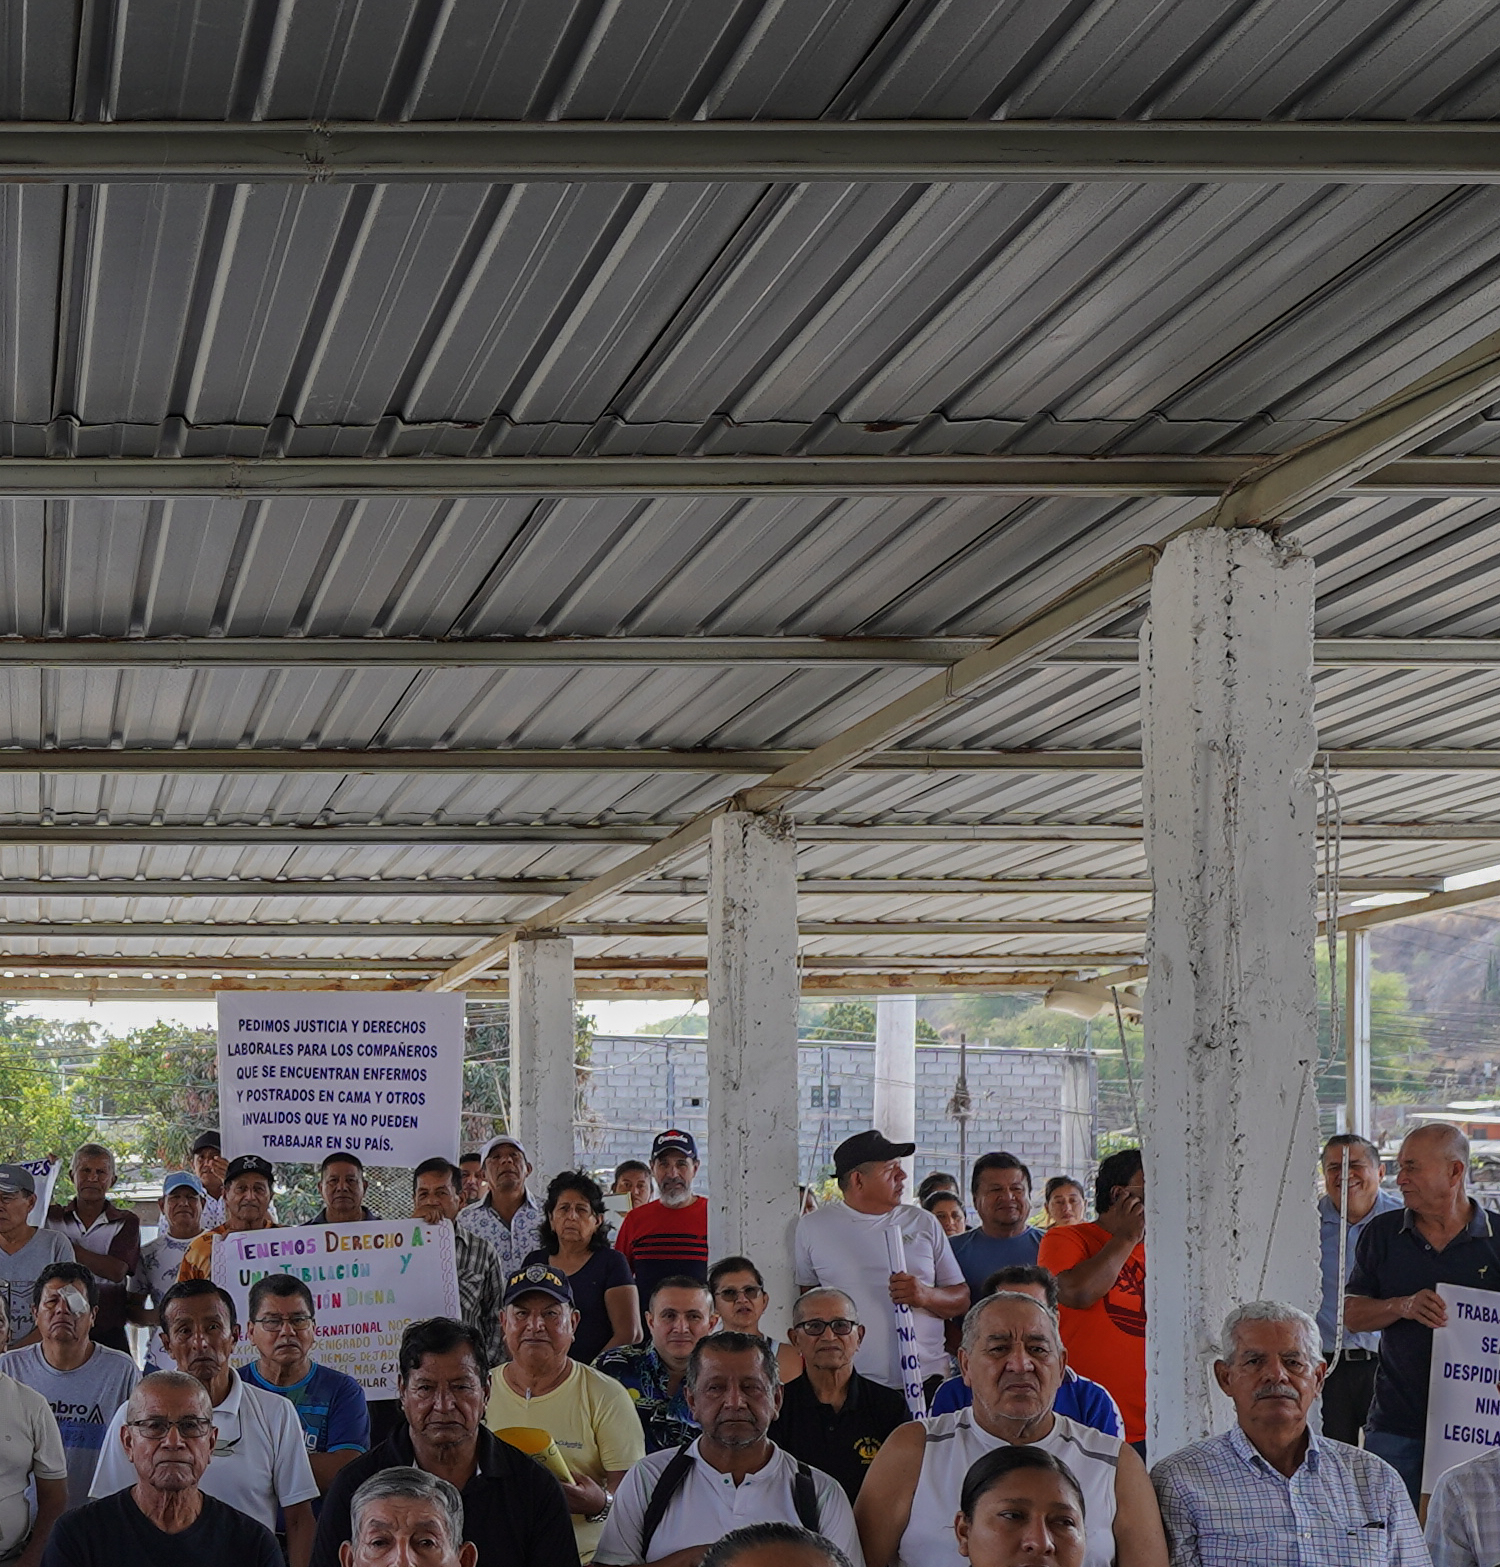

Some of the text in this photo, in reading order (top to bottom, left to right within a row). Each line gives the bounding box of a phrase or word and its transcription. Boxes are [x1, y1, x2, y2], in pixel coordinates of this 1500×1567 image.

[238, 1019, 426, 1034] PEDIMOS JUSTICIA Y DERECHOS
[228, 1042, 438, 1058] LABORALES PARA LOS COMPAÑEROS
[237, 1065, 427, 1082] QUE SE ENCUENTRAN ENFERMOS
[237, 1089, 425, 1105] Y POSTRADOS EN CAMA Y OTROS
[243, 1112, 418, 1128] INVALIDOS QUE YA NO PUEDEN
[263, 1135, 394, 1152] TRABAJAR EN SU PAÍS.
